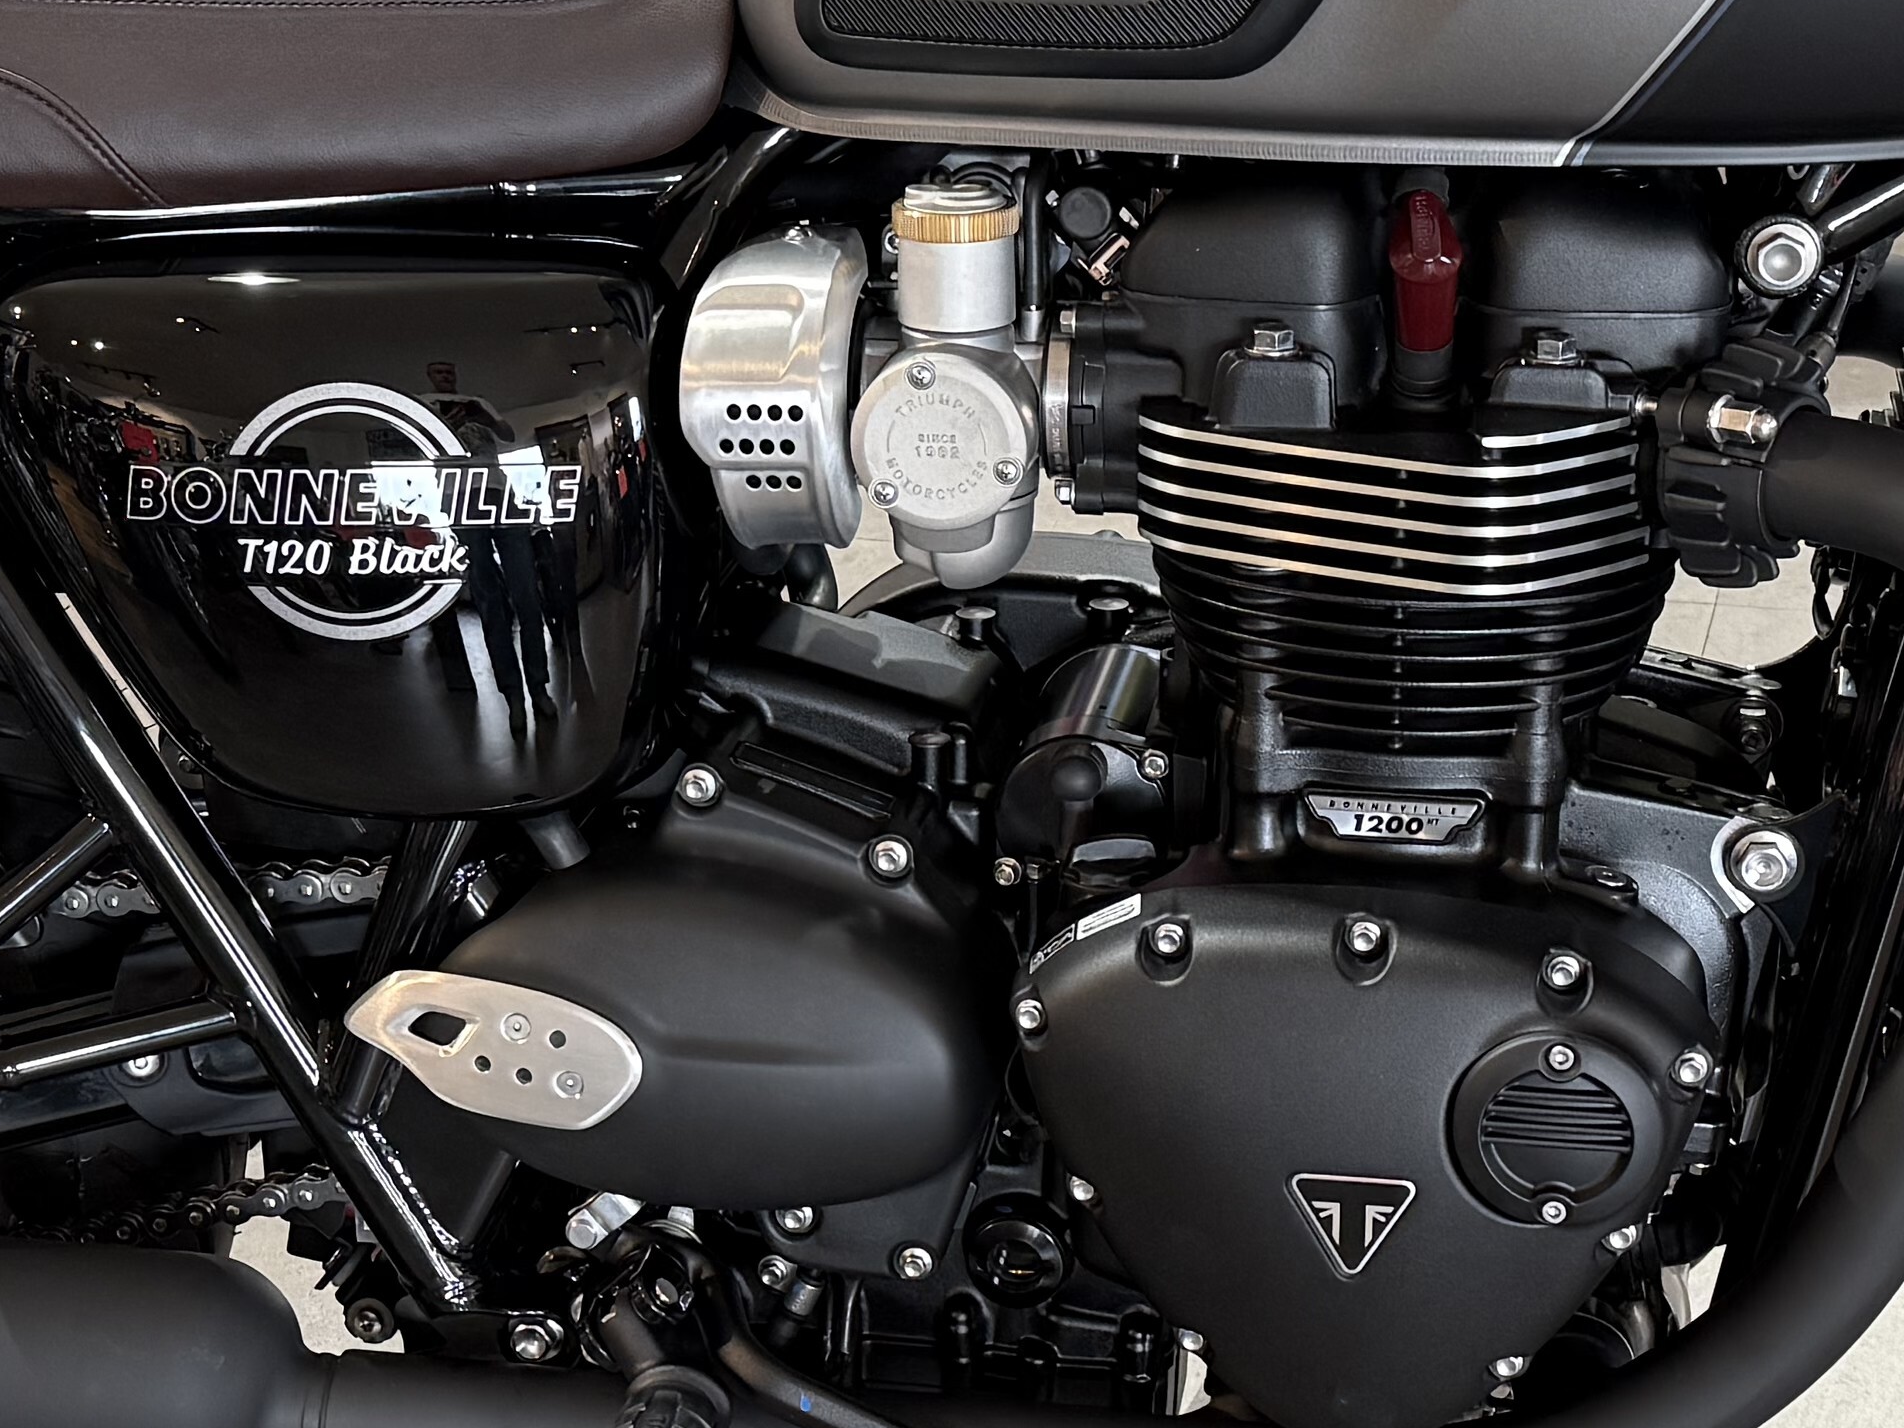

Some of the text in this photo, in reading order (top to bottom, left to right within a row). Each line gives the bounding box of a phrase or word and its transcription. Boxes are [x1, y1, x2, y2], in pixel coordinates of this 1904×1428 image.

[895, 393, 976, 420] TRIUMPH
[127, 464, 583, 525] BONNEVILLE
[238, 536, 470, 577] T120 Black
[1328, 799, 1457, 816] BONNEVILLE
[1353, 813, 1424, 835] 1200
